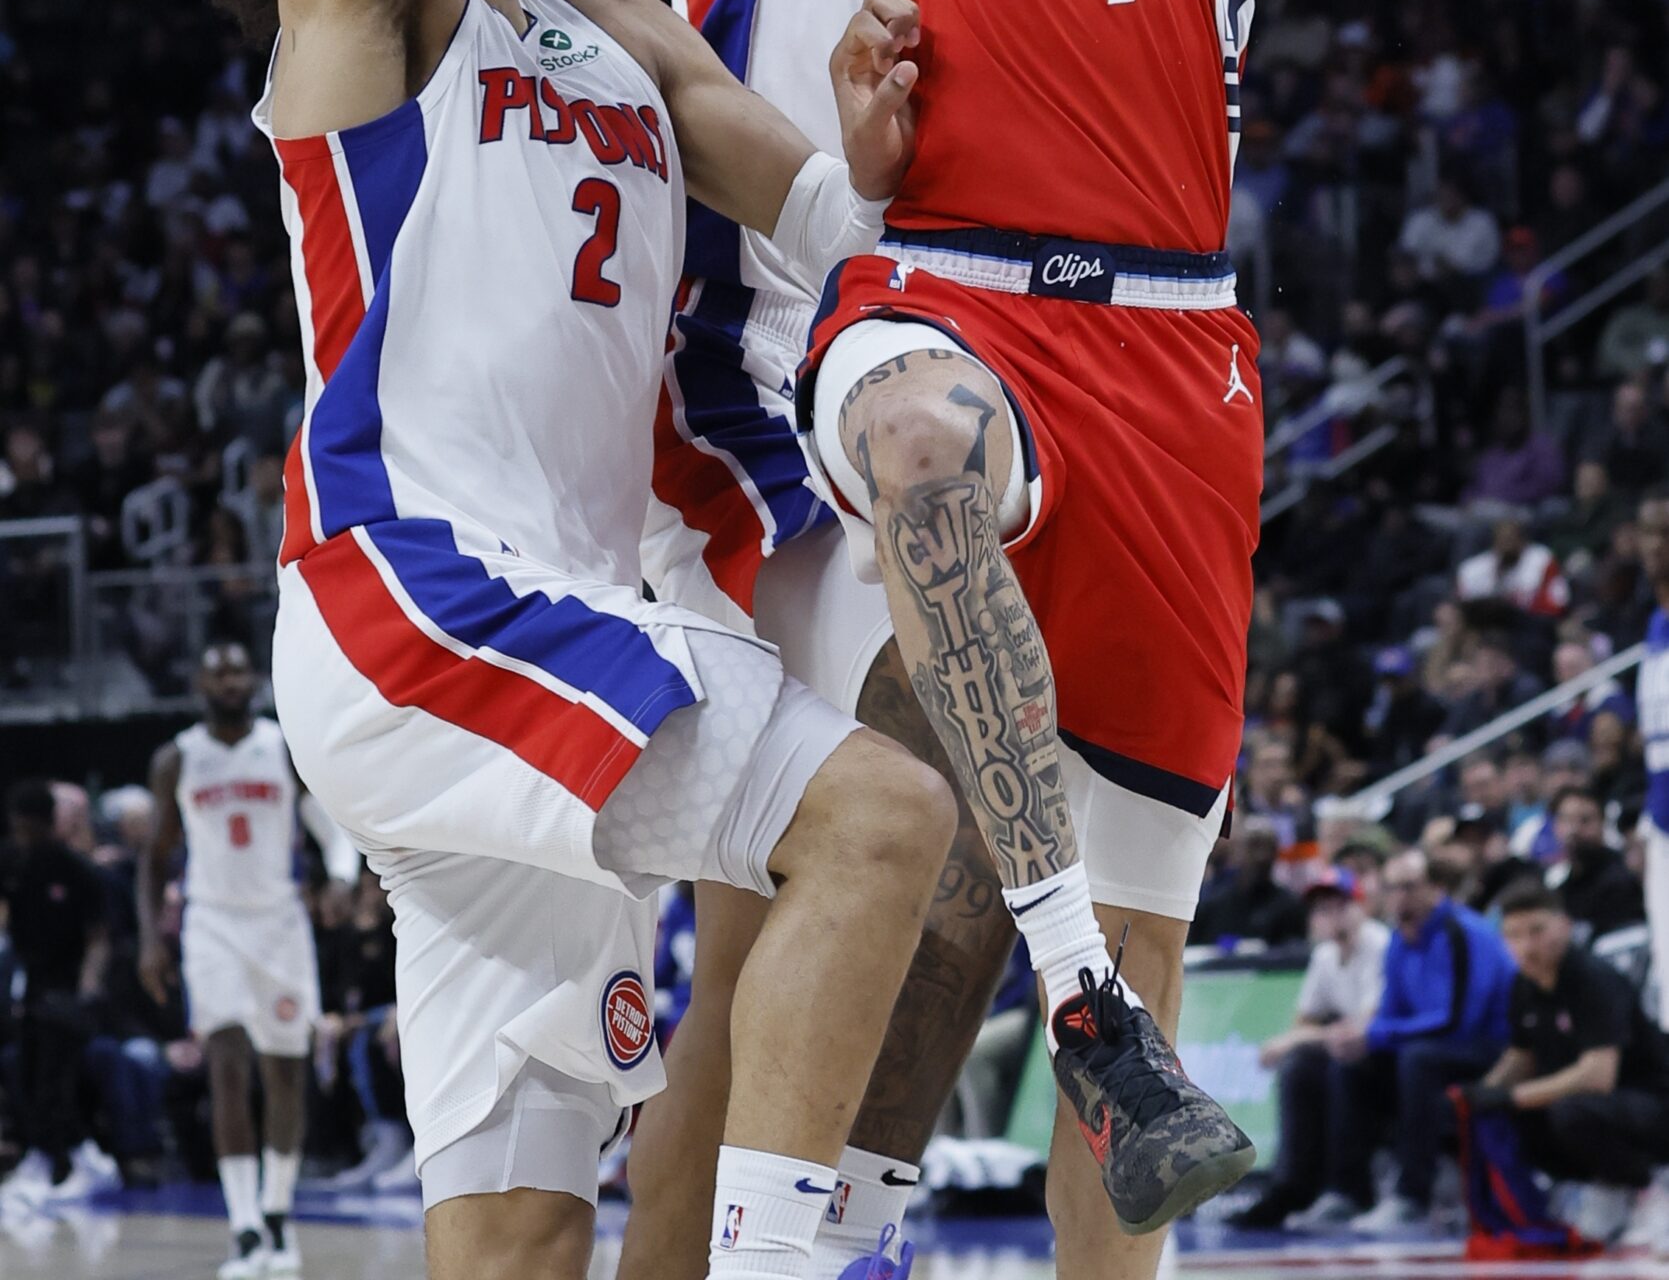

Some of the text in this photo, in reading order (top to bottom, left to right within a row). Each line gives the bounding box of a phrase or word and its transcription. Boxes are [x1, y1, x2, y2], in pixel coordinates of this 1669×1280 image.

[478, 66, 668, 184] PISONS
[570, 176, 621, 308] 2
[1041, 252, 1105, 289] Clips
[611, 1010, 643, 1045] PISTONS
[615, 995, 647, 1030] DETROIT
